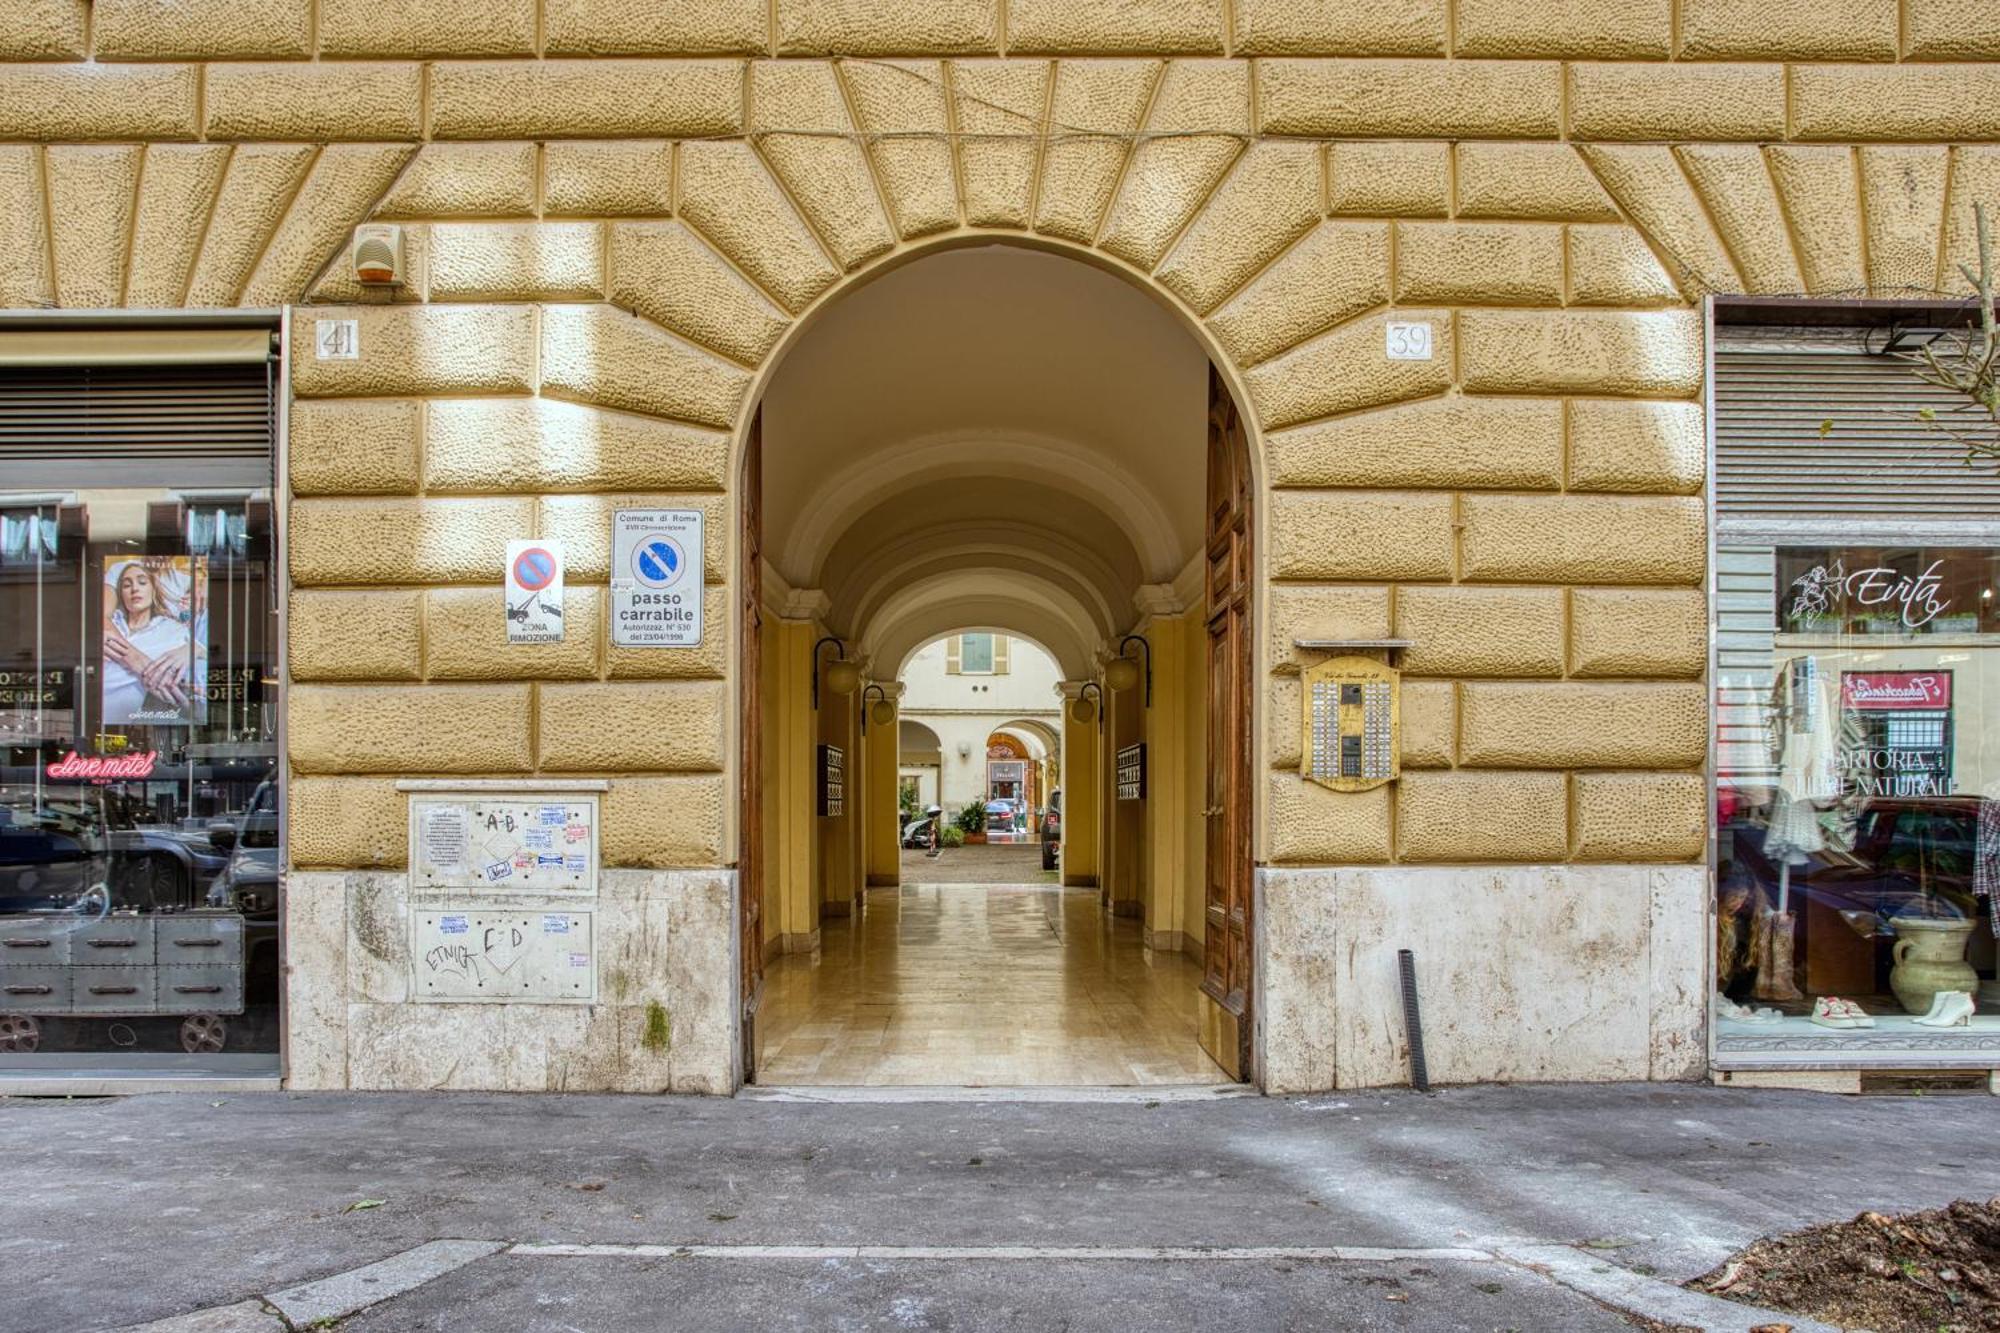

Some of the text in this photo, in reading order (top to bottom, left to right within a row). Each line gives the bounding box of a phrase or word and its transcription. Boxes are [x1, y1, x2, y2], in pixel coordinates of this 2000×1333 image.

[323, 325, 352, 354] 41
[1393, 327, 1426, 354] 39
[619, 514, 697, 522] Comune di Roma
[632, 594, 682, 607] passo
[620, 608, 694, 621] carrabile
[510, 634, 561, 642] RIMOZIONE
[629, 633, 642, 641] del
[101, 749, 157, 778] motel
